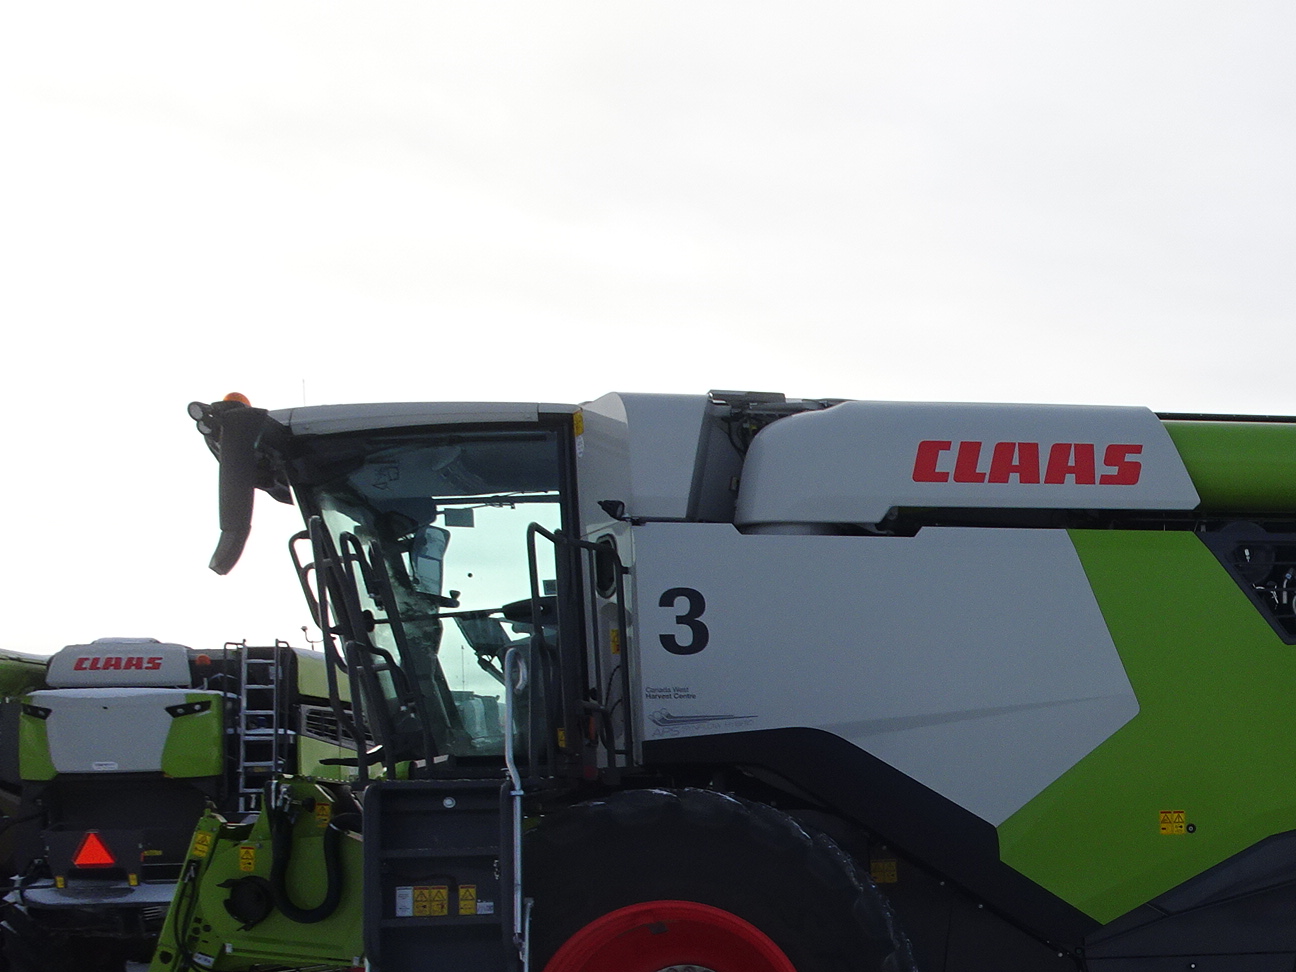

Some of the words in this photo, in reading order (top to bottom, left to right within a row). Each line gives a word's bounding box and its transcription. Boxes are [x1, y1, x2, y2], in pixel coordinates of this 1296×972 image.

[912, 440, 1144, 486] CLAAS
[658, 587, 710, 655] 3
[73, 656, 163, 671] CLAAS
[673, 692, 697, 700] Centre
[652, 727, 681, 737] APS
